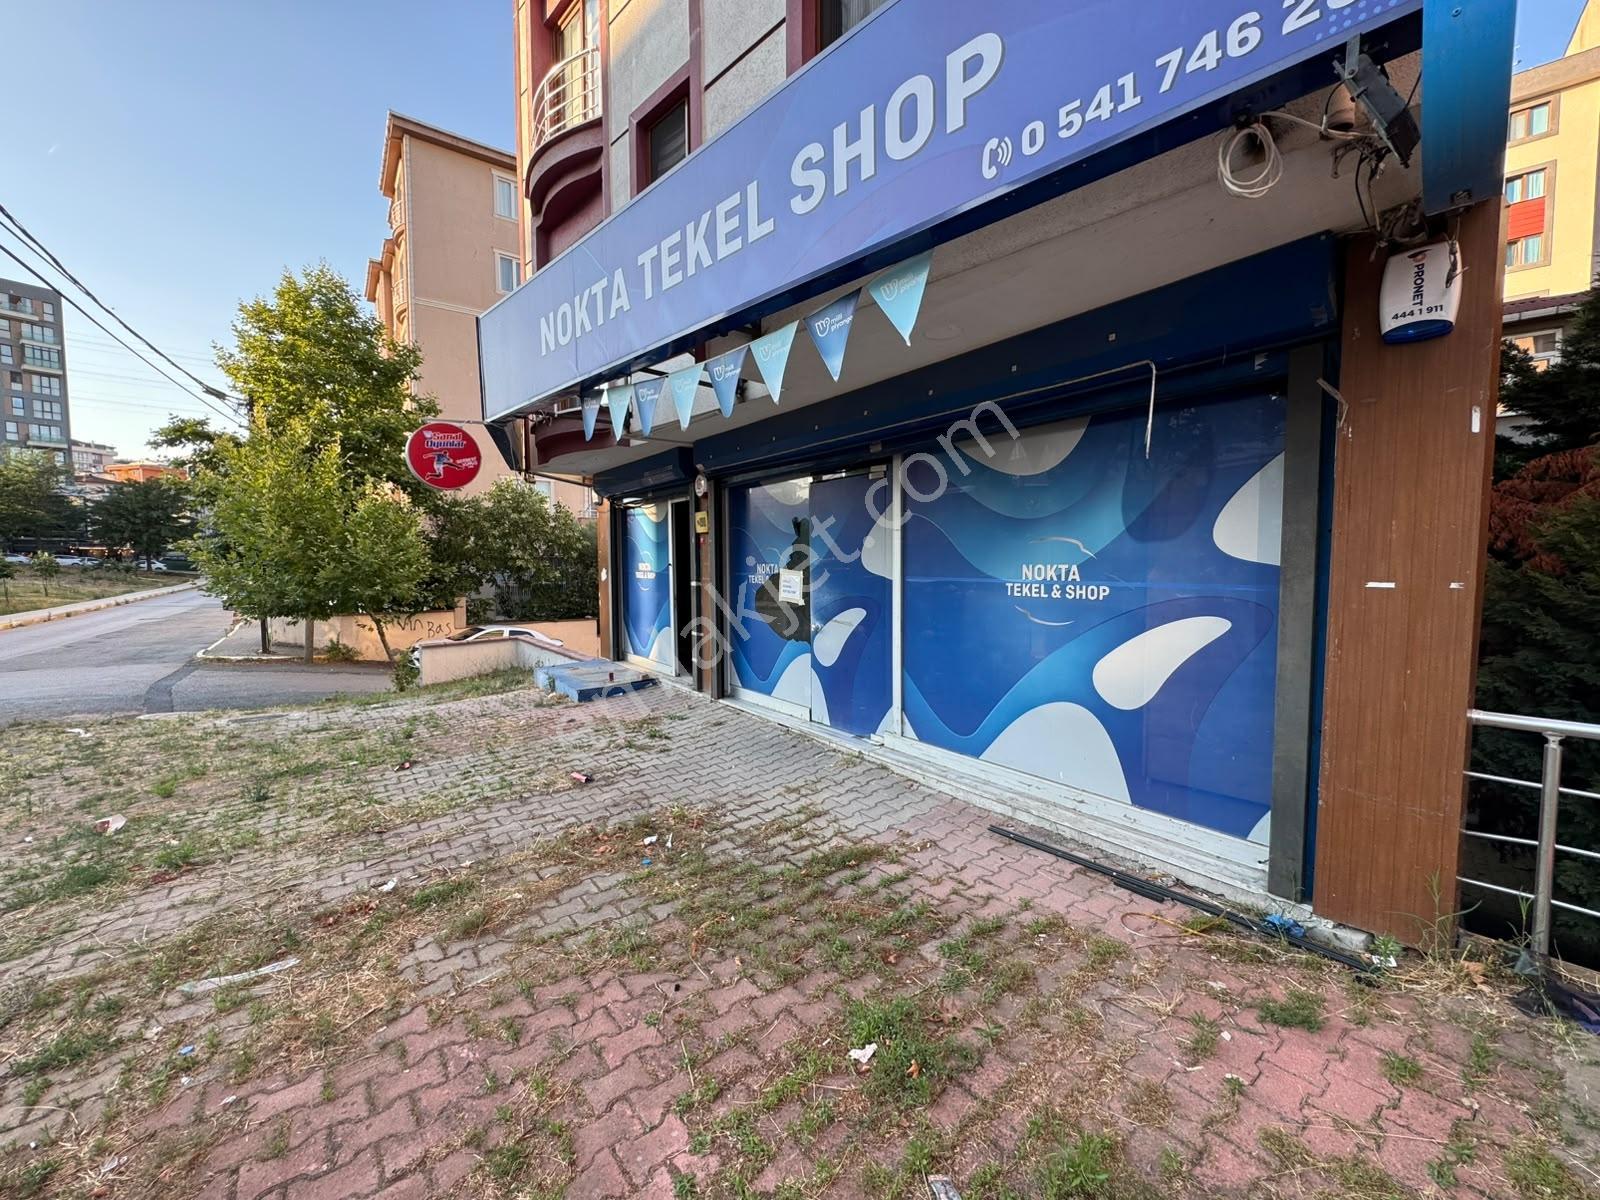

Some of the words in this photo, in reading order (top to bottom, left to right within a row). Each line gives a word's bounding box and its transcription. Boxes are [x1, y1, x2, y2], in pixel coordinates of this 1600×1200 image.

[1021, 120, 1045, 157] 0
[1057, 73, 1143, 139] 541
[1156, 11, 1262, 93] 746
[1281, 0, 1356, 36] 2
[539, 267, 631, 357] NOKTA
[638, 180, 775, 301] TEKEL
[790, 31, 1005, 215] SHOP
[1412, 262, 1425, 307] PRONET
[1391, 309, 1415, 320] 444
[1417, 308, 1423, 316] 1
[1426, 304, 1444, 314] 911
[756, 563, 780, 575] NOKTA
[1021, 564, 1081, 582] NOKTA
[1005, 582, 1048, 598] TEKEL
[1051, 584, 1062, 599] &
[1065, 585, 1110, 601] SHOP
